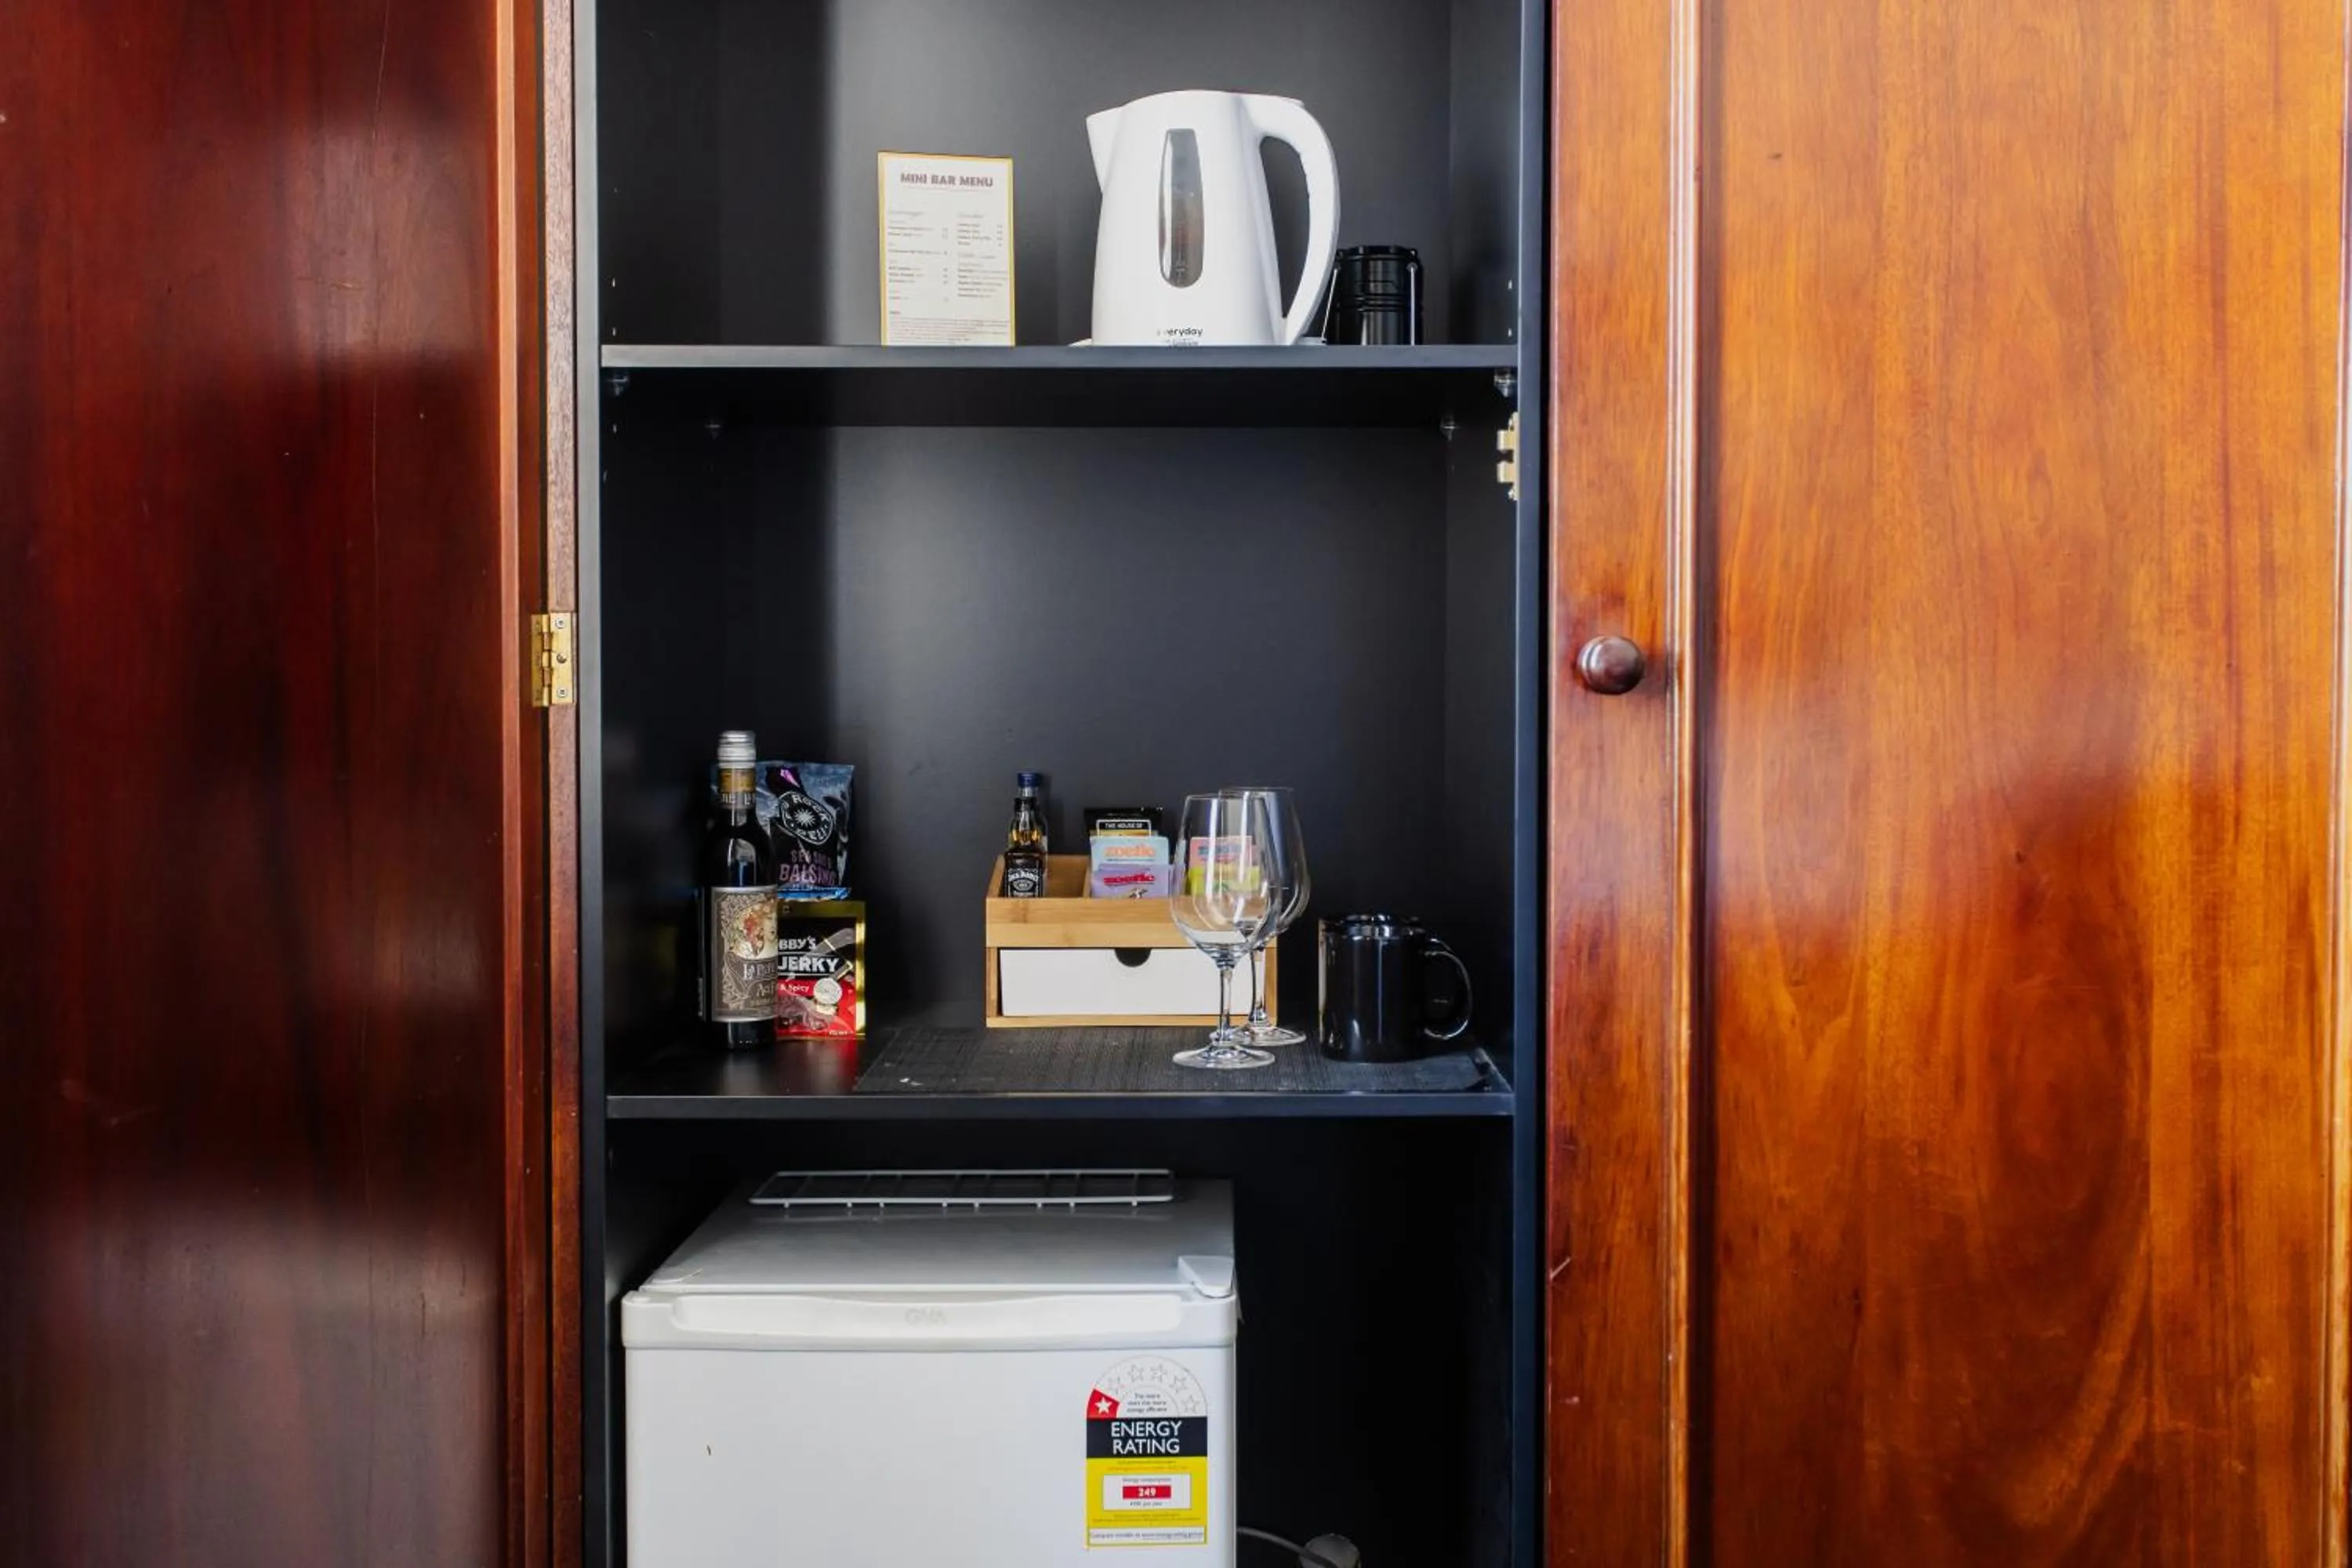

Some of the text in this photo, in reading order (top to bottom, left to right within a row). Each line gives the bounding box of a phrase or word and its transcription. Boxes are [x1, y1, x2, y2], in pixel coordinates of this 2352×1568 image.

[900, 172, 993, 187] MINI BAR MENU
[779, 936, 817, 951] BBY'S
[777, 956, 839, 972] JERKY
[1111, 1421, 1182, 1437] ENERGY
[1112, 1438, 1180, 1455] RATING
[1138, 1486, 1156, 1497] 249
